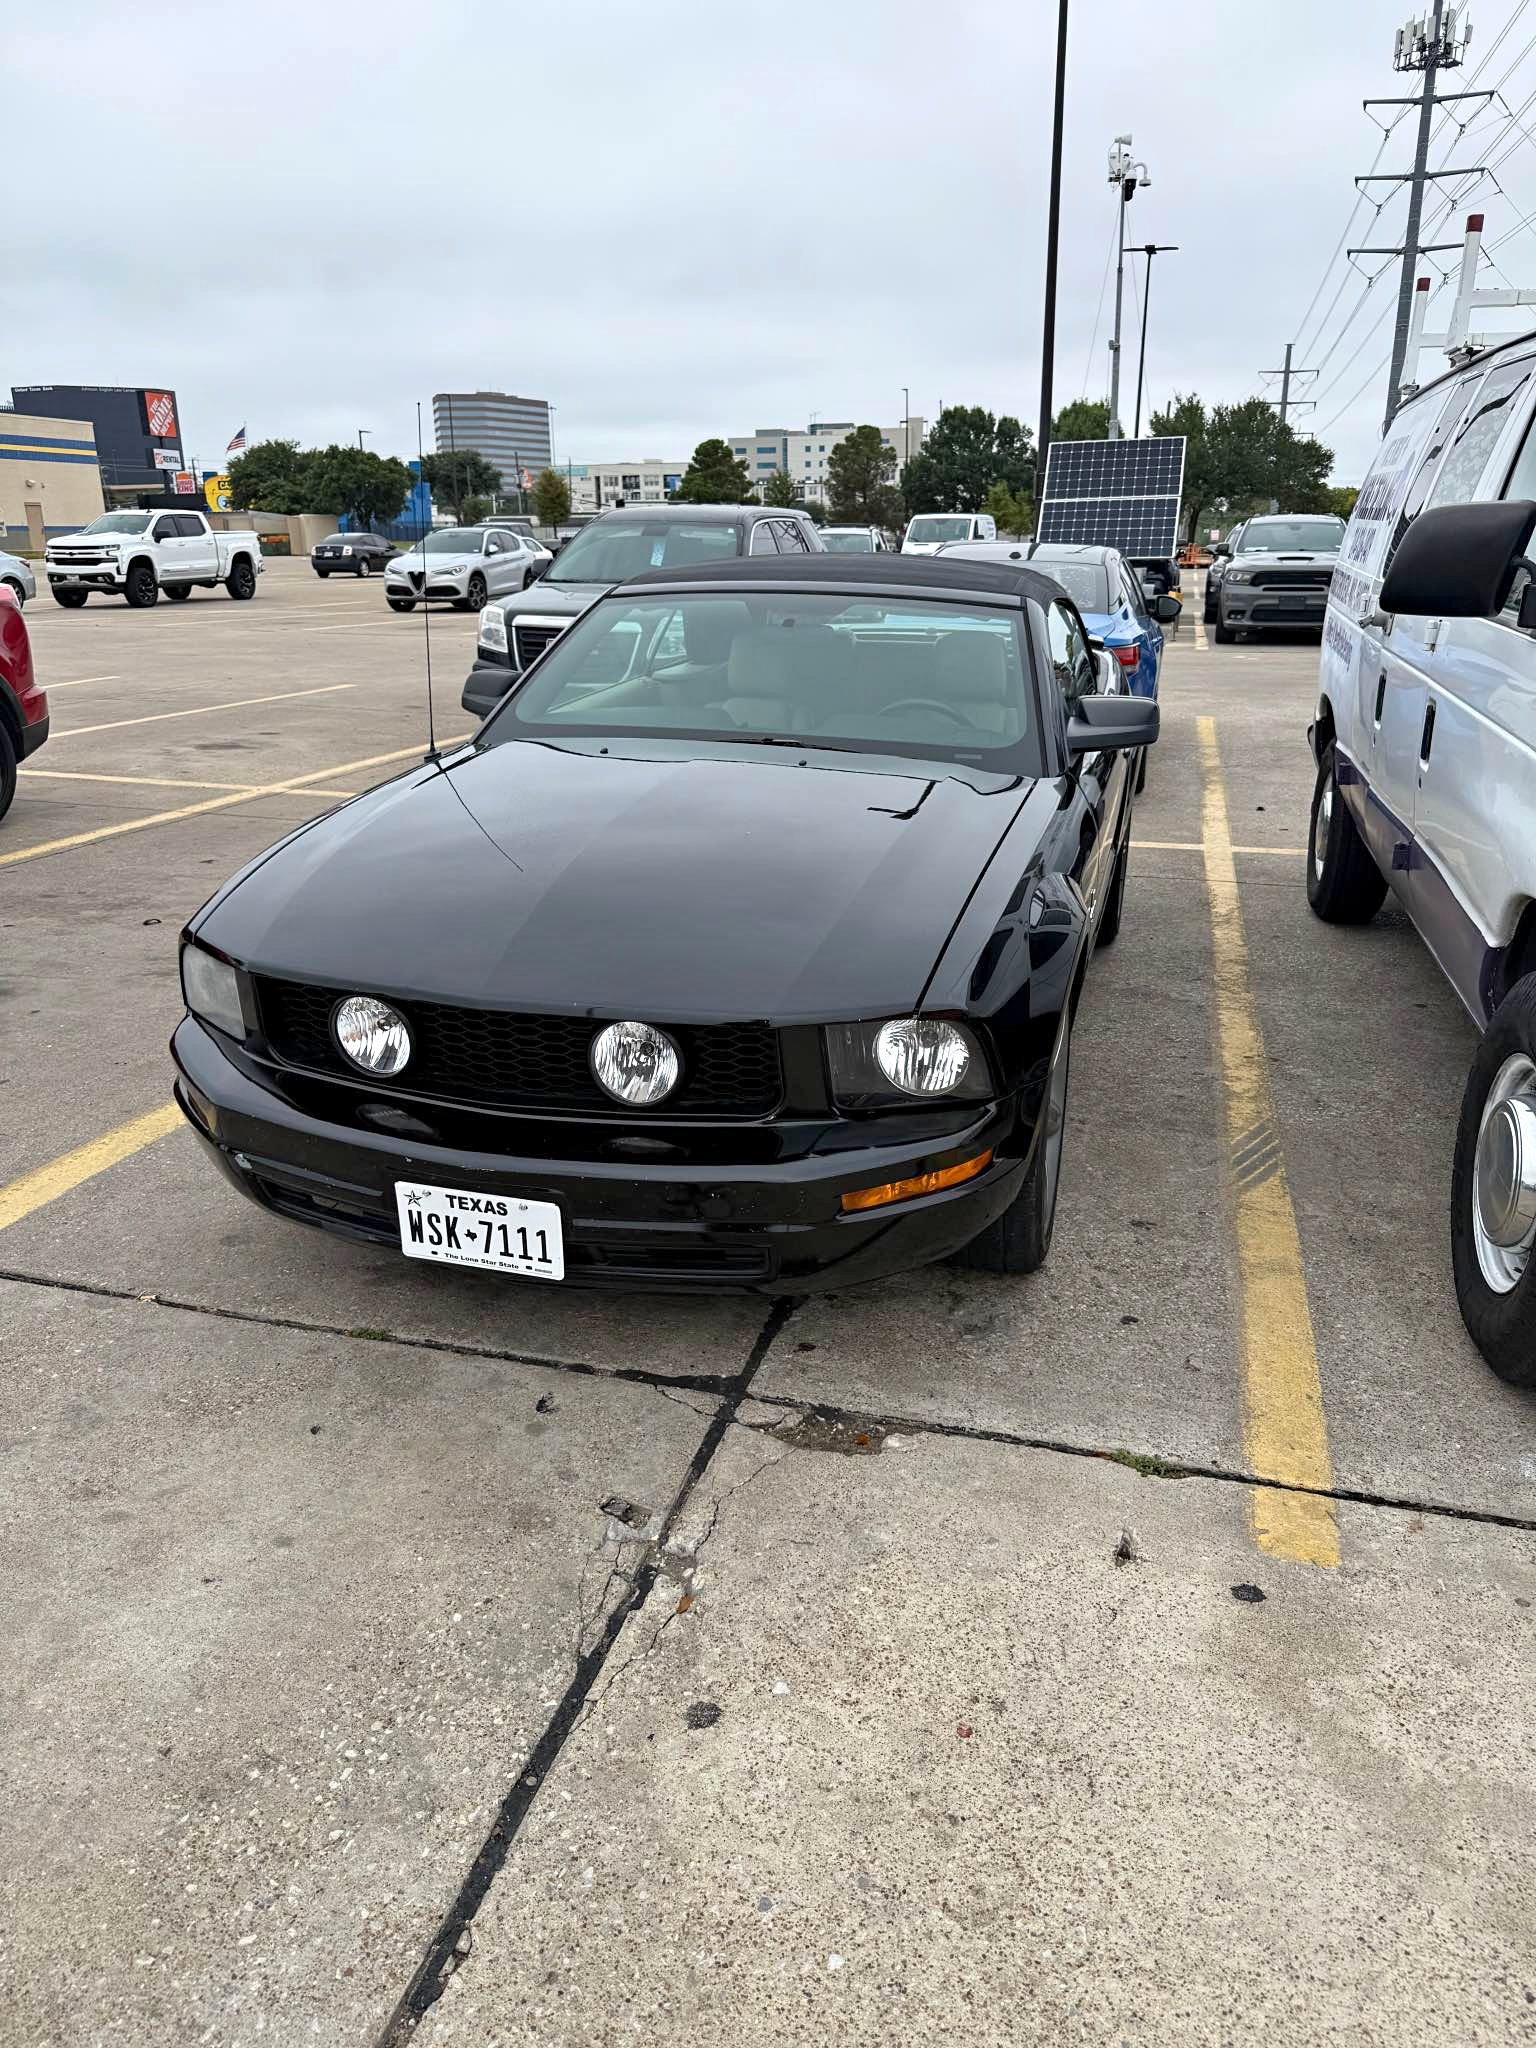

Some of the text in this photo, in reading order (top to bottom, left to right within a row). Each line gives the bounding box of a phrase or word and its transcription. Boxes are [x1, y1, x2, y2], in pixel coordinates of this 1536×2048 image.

[149, 395, 173, 435] HOME
[163, 455, 181, 464] RENTAL
[178, 485, 194, 493] KING
[445, 1194, 508, 1216] TEXAS
[444, 1252, 519, 1270] The Lone Star State
